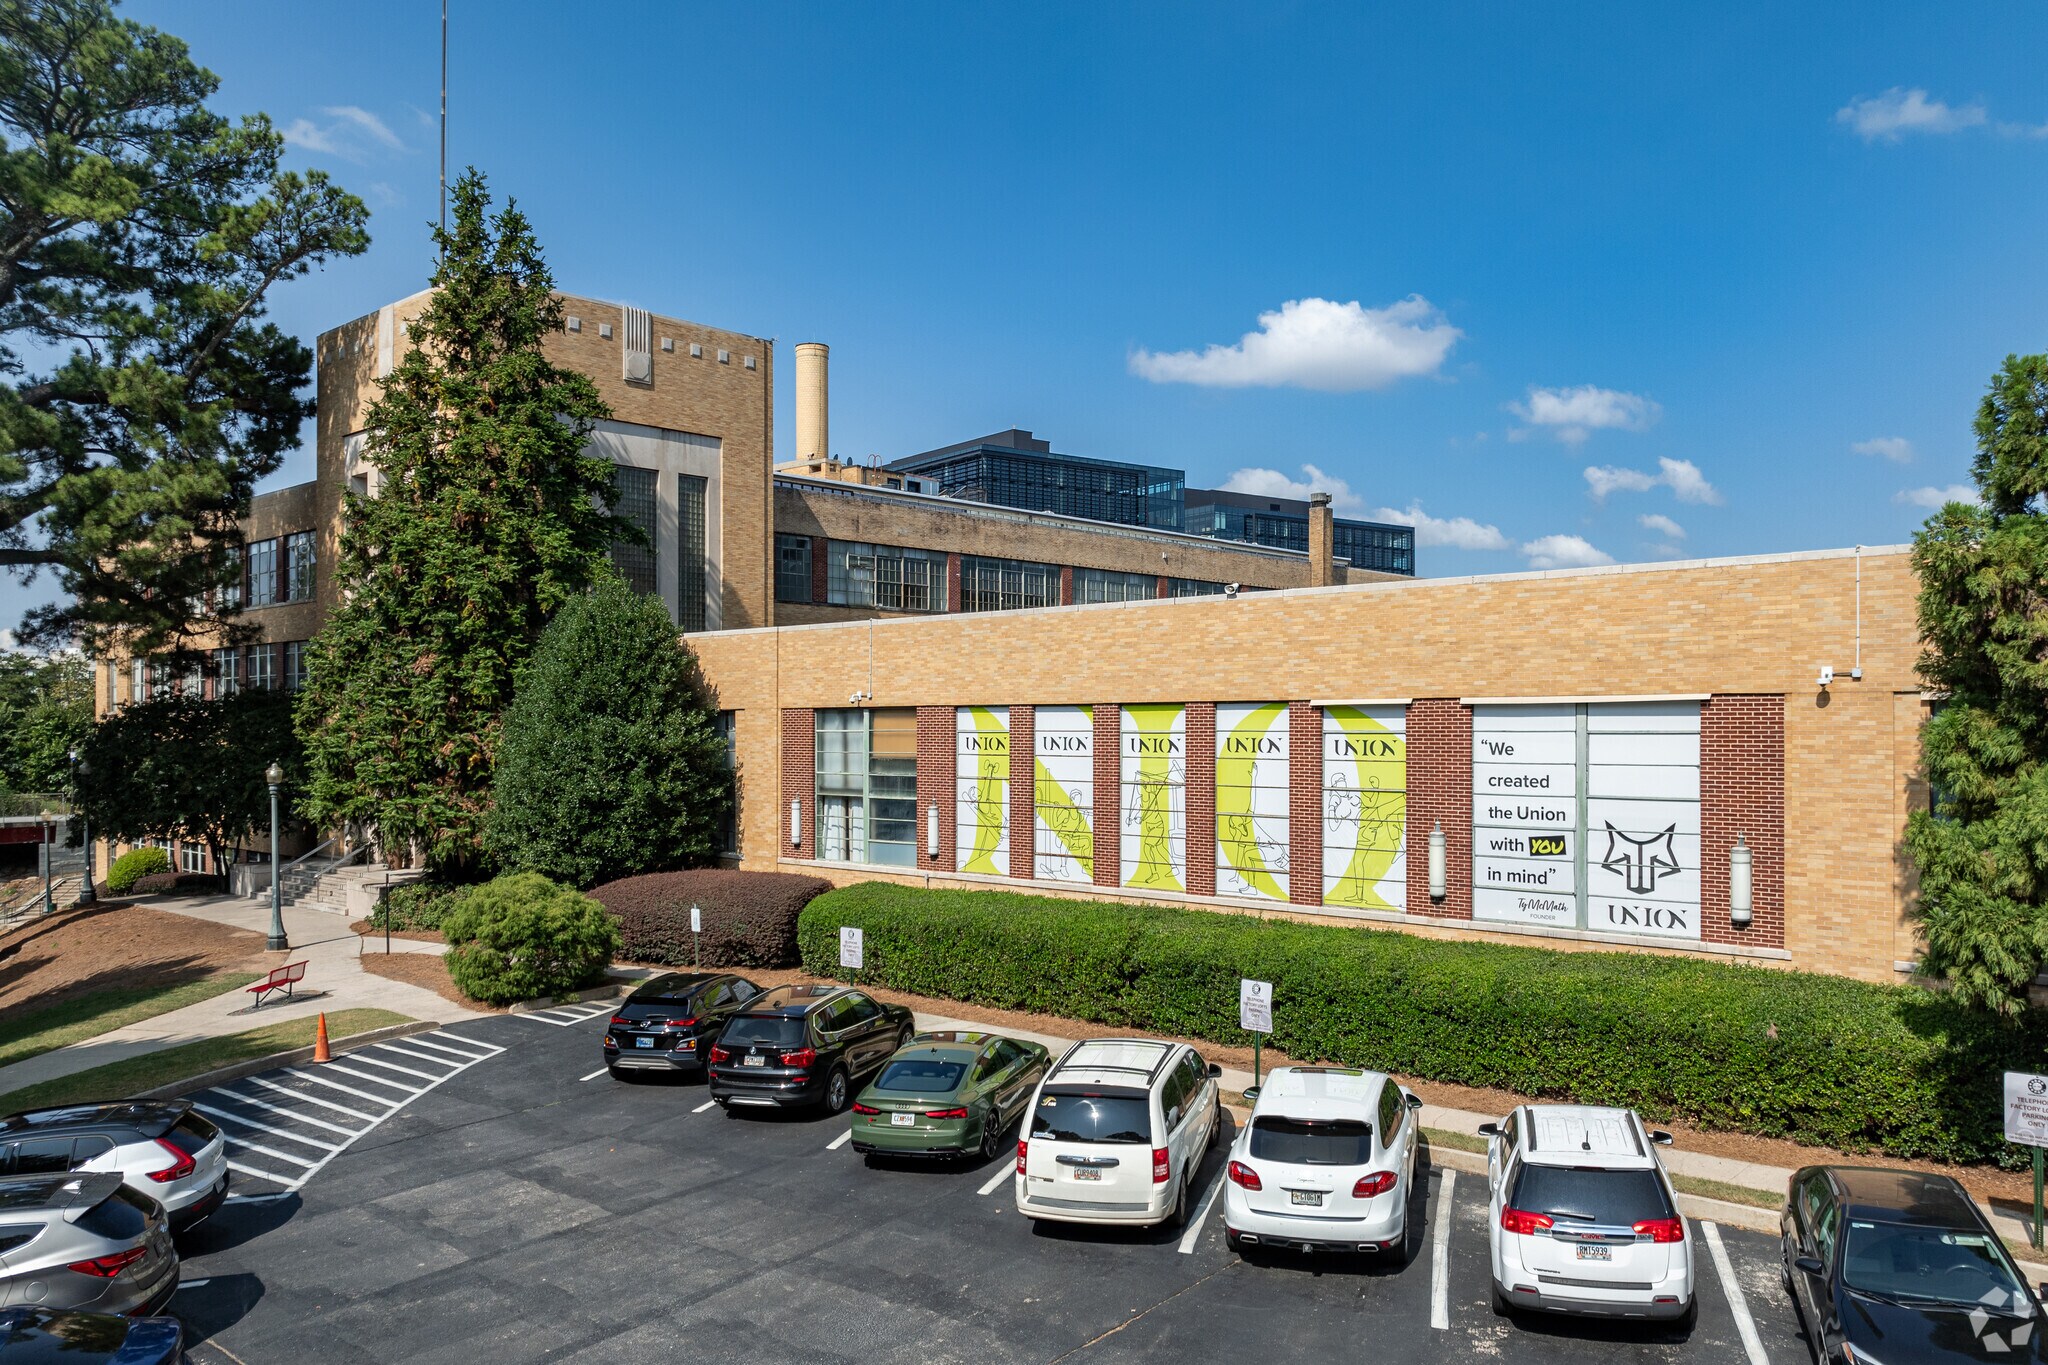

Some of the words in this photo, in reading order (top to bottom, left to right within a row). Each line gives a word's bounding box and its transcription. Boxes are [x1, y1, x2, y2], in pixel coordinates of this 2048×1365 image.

[966, 737, 1007, 751] UNION
[1043, 737, 1088, 751] UNION
[1131, 738, 1180, 753] UNION
[1226, 737, 1282, 754] UNION
[1334, 739, 1397, 756] UNION
[1488, 774, 1550, 789] created
[1488, 806, 1513, 820] the
[1517, 806, 1566, 821] Union
[1490, 837, 1524, 852] with
[1531, 839, 1565, 855] YOU
[1488, 867, 1502, 882] in
[1530, 913, 1556, 921] FOUNDER
[1608, 904, 1687, 930] UNION
[2017, 1097, 2048, 1105] TELEPHO
